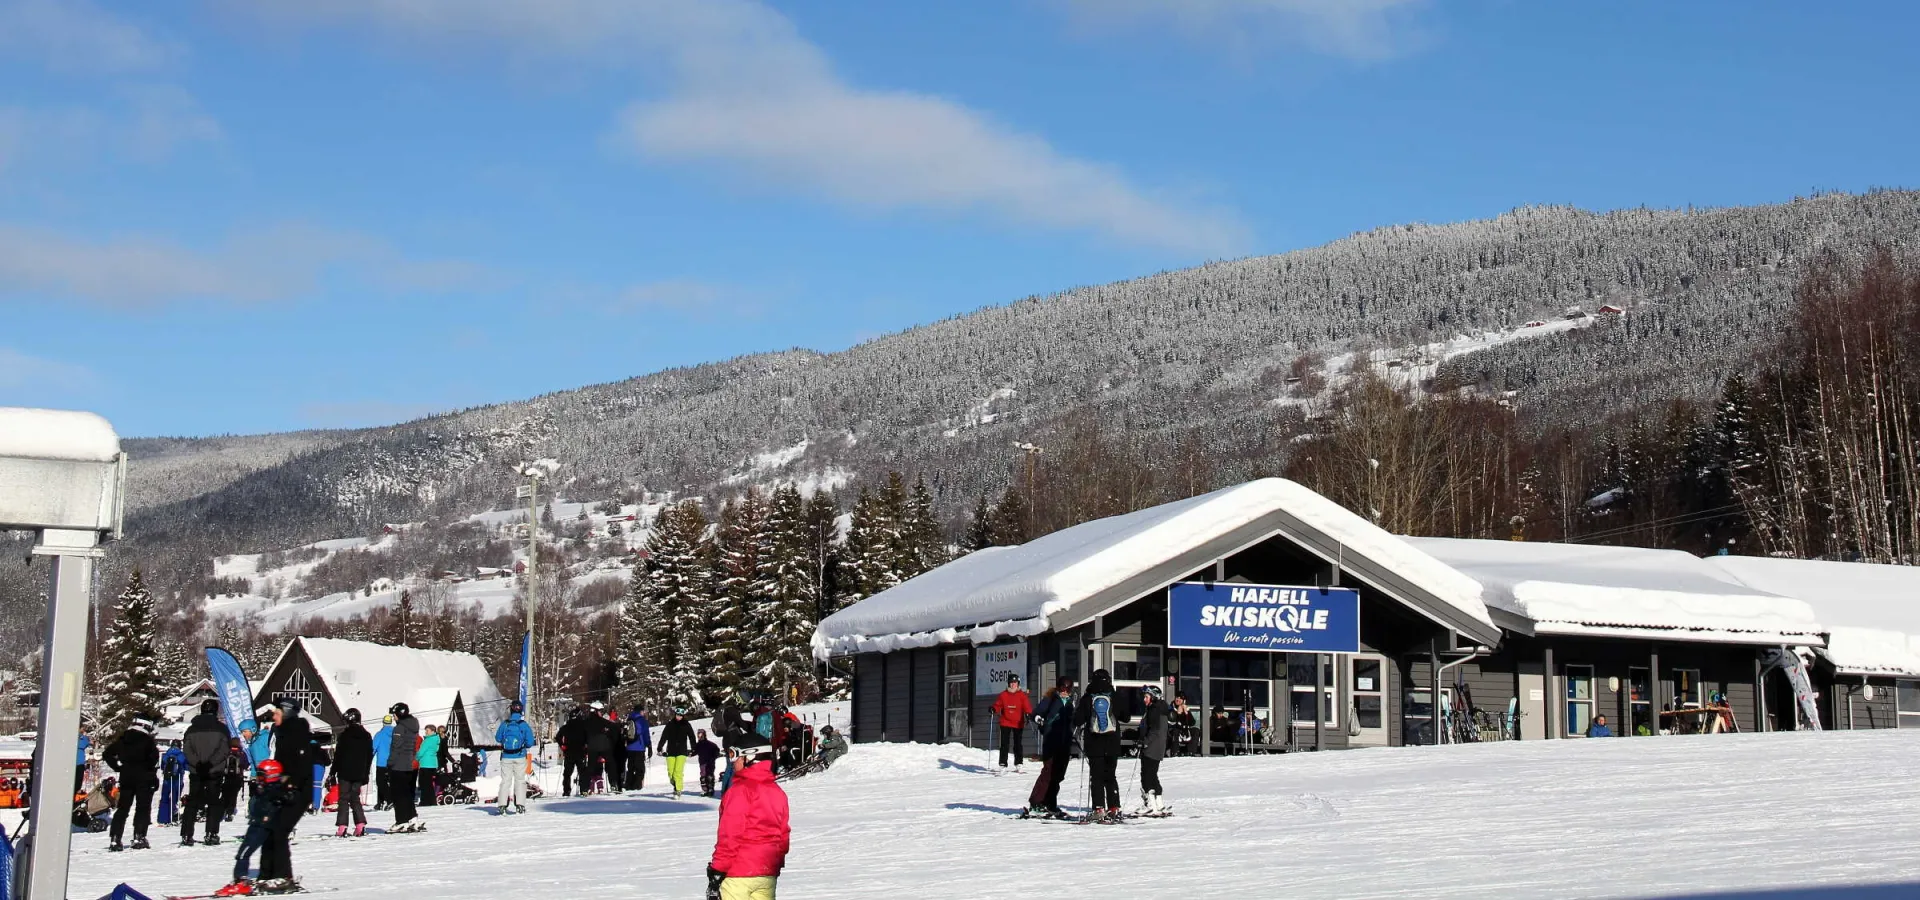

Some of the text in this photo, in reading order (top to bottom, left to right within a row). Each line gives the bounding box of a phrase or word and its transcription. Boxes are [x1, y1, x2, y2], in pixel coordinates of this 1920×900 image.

[1230, 587, 1310, 605] HAFJELL
[1223, 630, 1304, 647] We create passion
